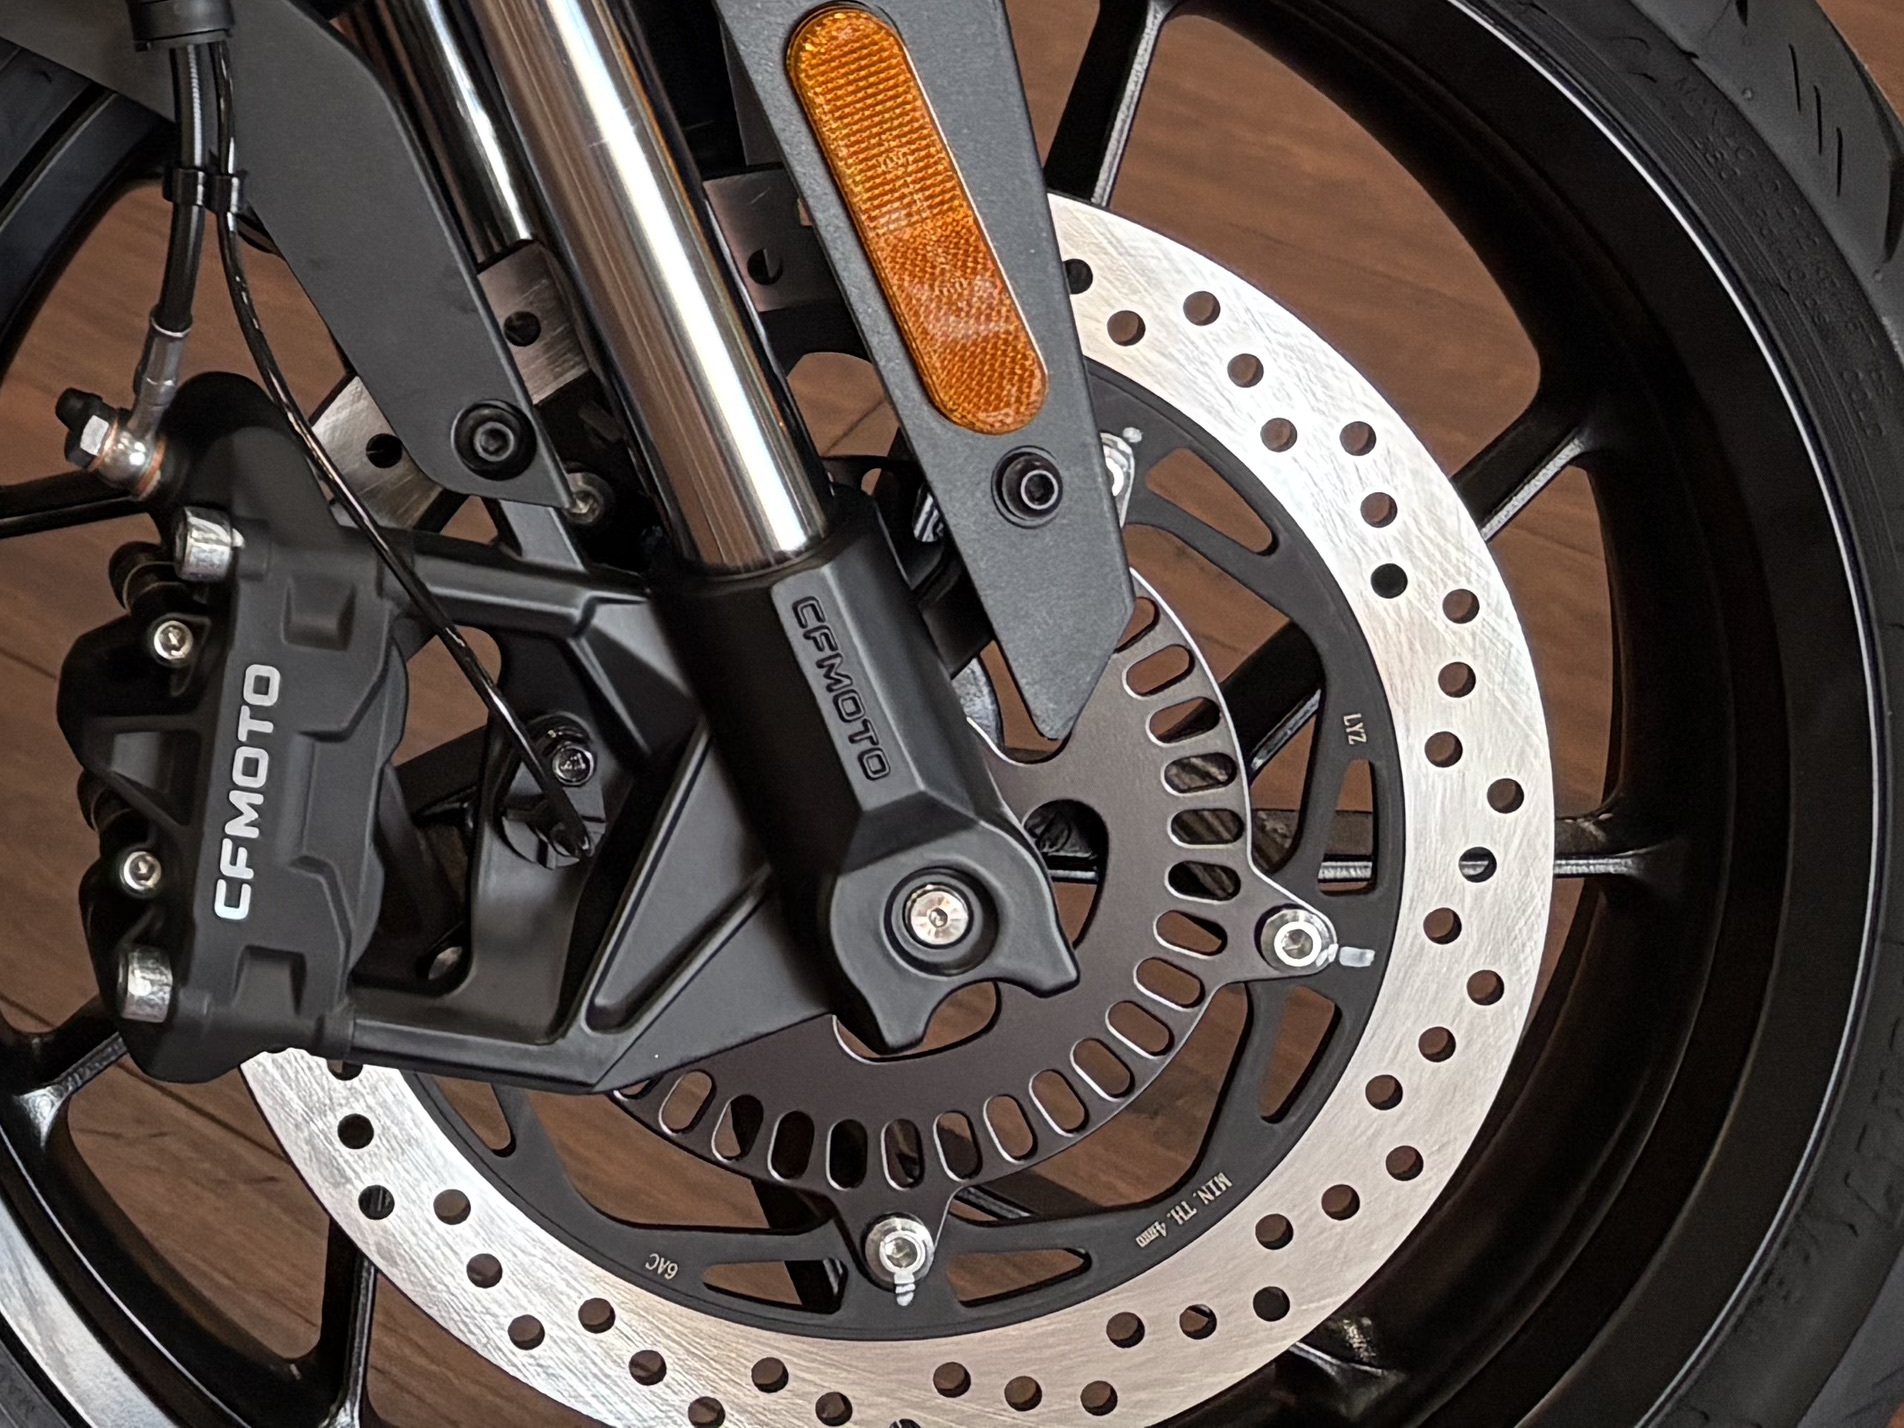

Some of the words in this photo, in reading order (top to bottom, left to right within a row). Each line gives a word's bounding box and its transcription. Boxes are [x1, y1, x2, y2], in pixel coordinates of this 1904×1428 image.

[791, 594, 892, 782] CFMOTO
[1343, 712, 1367, 745] LYZ
[213, 662, 282, 922] CFMOTO
[1192, 1171, 1233, 1205] MIN.
[1166, 1200, 1198, 1225] TH.
[645, 1252, 679, 1280] 6AC
